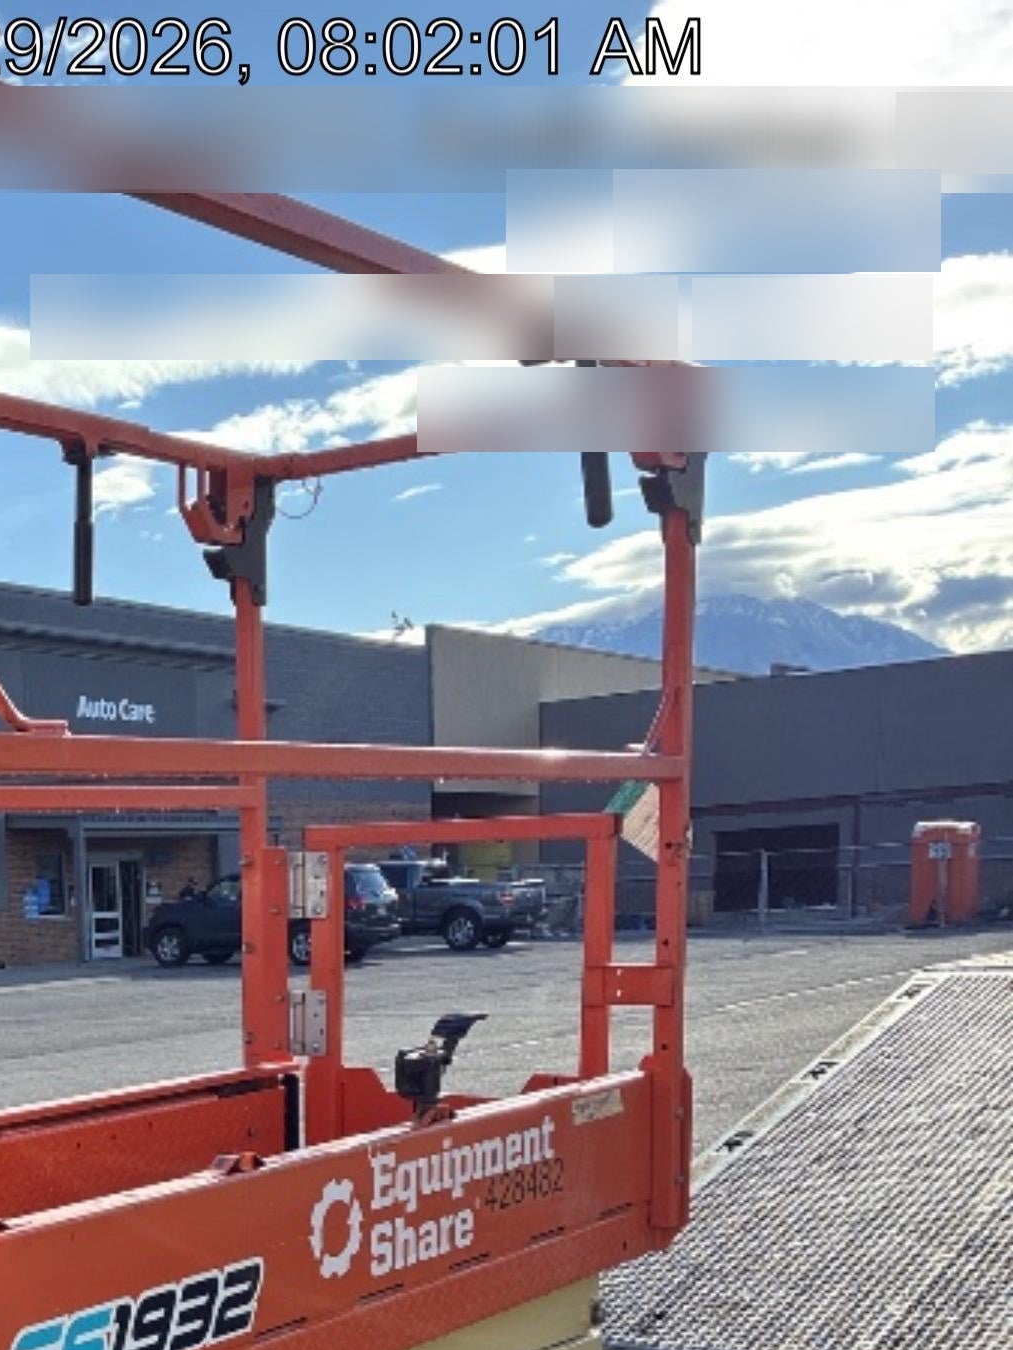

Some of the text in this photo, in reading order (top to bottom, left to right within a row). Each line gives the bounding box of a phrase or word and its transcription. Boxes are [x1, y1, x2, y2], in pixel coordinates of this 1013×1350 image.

[76, 695, 156, 724] Auto Care
[371, 1115, 555, 1212] Equipment
[484, 1156, 565, 1212] 428482
[370, 1207, 476, 1277] Share
